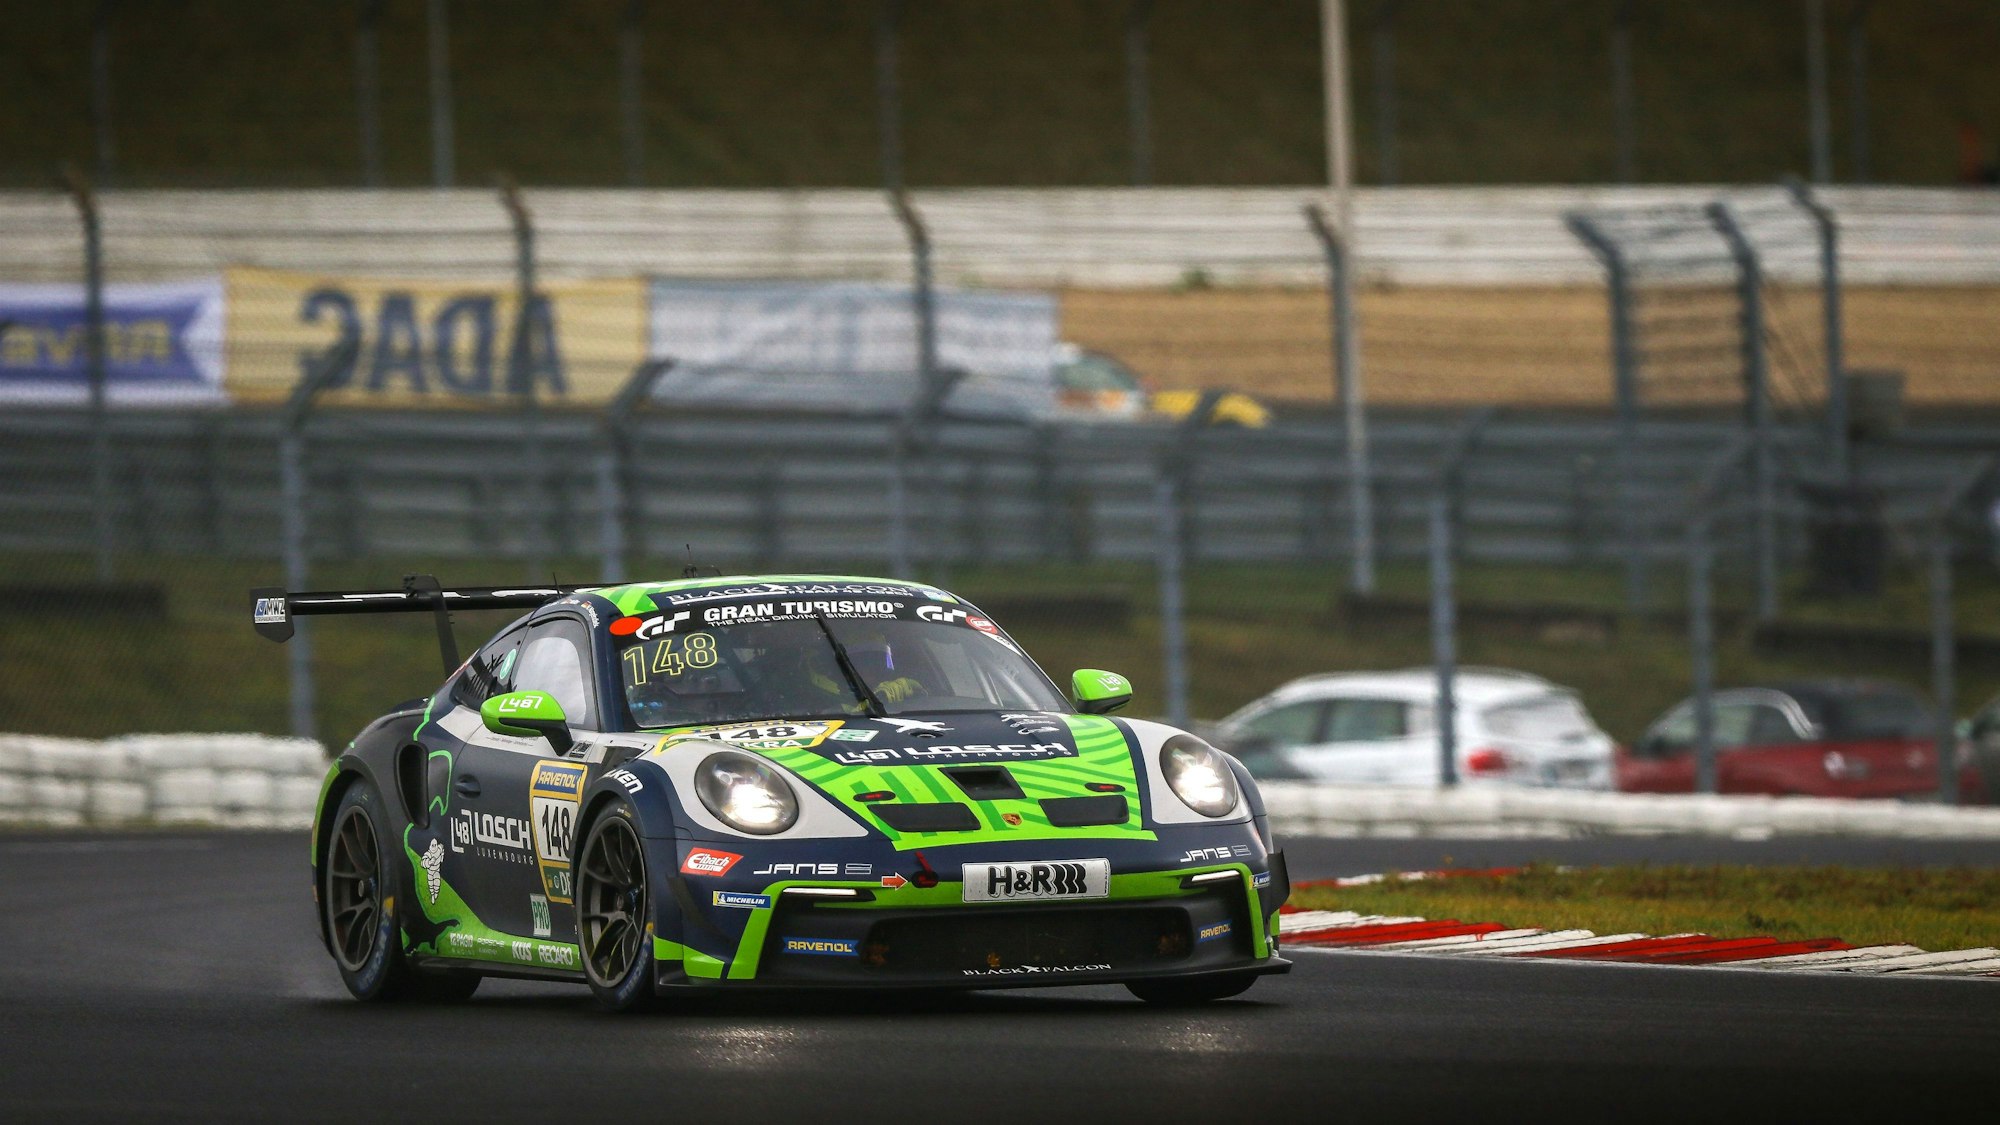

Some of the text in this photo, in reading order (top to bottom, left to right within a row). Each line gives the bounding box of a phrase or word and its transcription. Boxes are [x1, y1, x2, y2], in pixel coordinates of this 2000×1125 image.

[666, 585, 908, 602] BLACK FALCON
[704, 603, 773, 621] GRAN
[708, 619, 735, 628] THE
[736, 616, 771, 625] REAL
[826, 612, 898, 620] SIMULATOR
[623, 632, 718, 685] 148
[698, 726, 797, 740] 148
[744, 739, 803, 748] KRA
[903, 743, 1071, 755] LOSCH
[912, 751, 1072, 760] LUXEMBOURG
[537, 771, 576, 789] RAVENOL
[474, 812, 532, 850] LOSCH
[541, 804, 571, 859] 148
[477, 846, 534, 865] LUXEMBOURG
[687, 853, 730, 872] Eibach
[753, 863, 838, 875] JANS
[988, 864, 1053, 895] H&R
[726, 896, 766, 905] MICHELIN
[1200, 924, 1231, 939] RAVENOL
[788, 940, 852, 953] RAVENOL
[538, 944, 574, 966] RECARO
[963, 963, 1112, 976] BLACK FALCON
